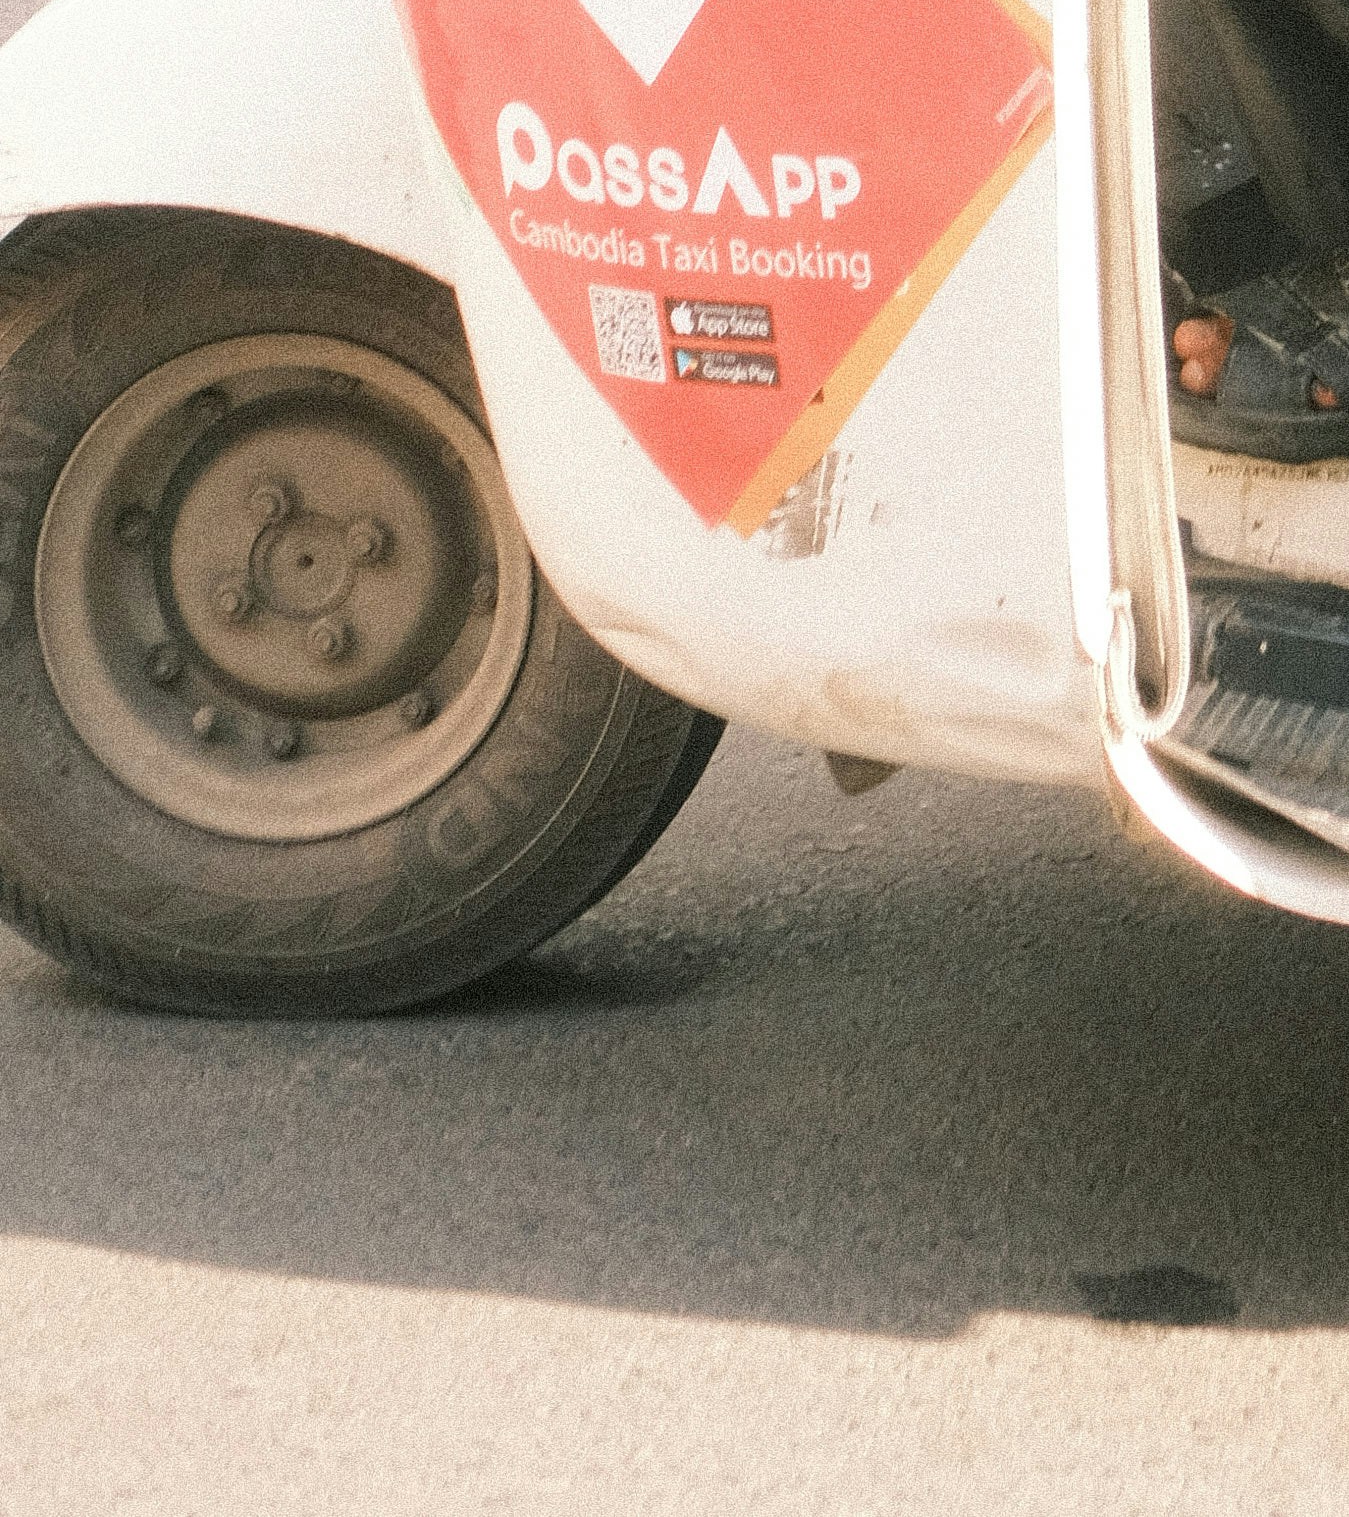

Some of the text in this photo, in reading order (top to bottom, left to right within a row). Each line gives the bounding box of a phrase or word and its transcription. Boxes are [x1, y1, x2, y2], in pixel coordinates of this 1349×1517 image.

[509, 207, 872, 291] Cambodia Taxi Booking
[697, 311, 770, 337] App Store
[702, 362, 748, 384] Google
